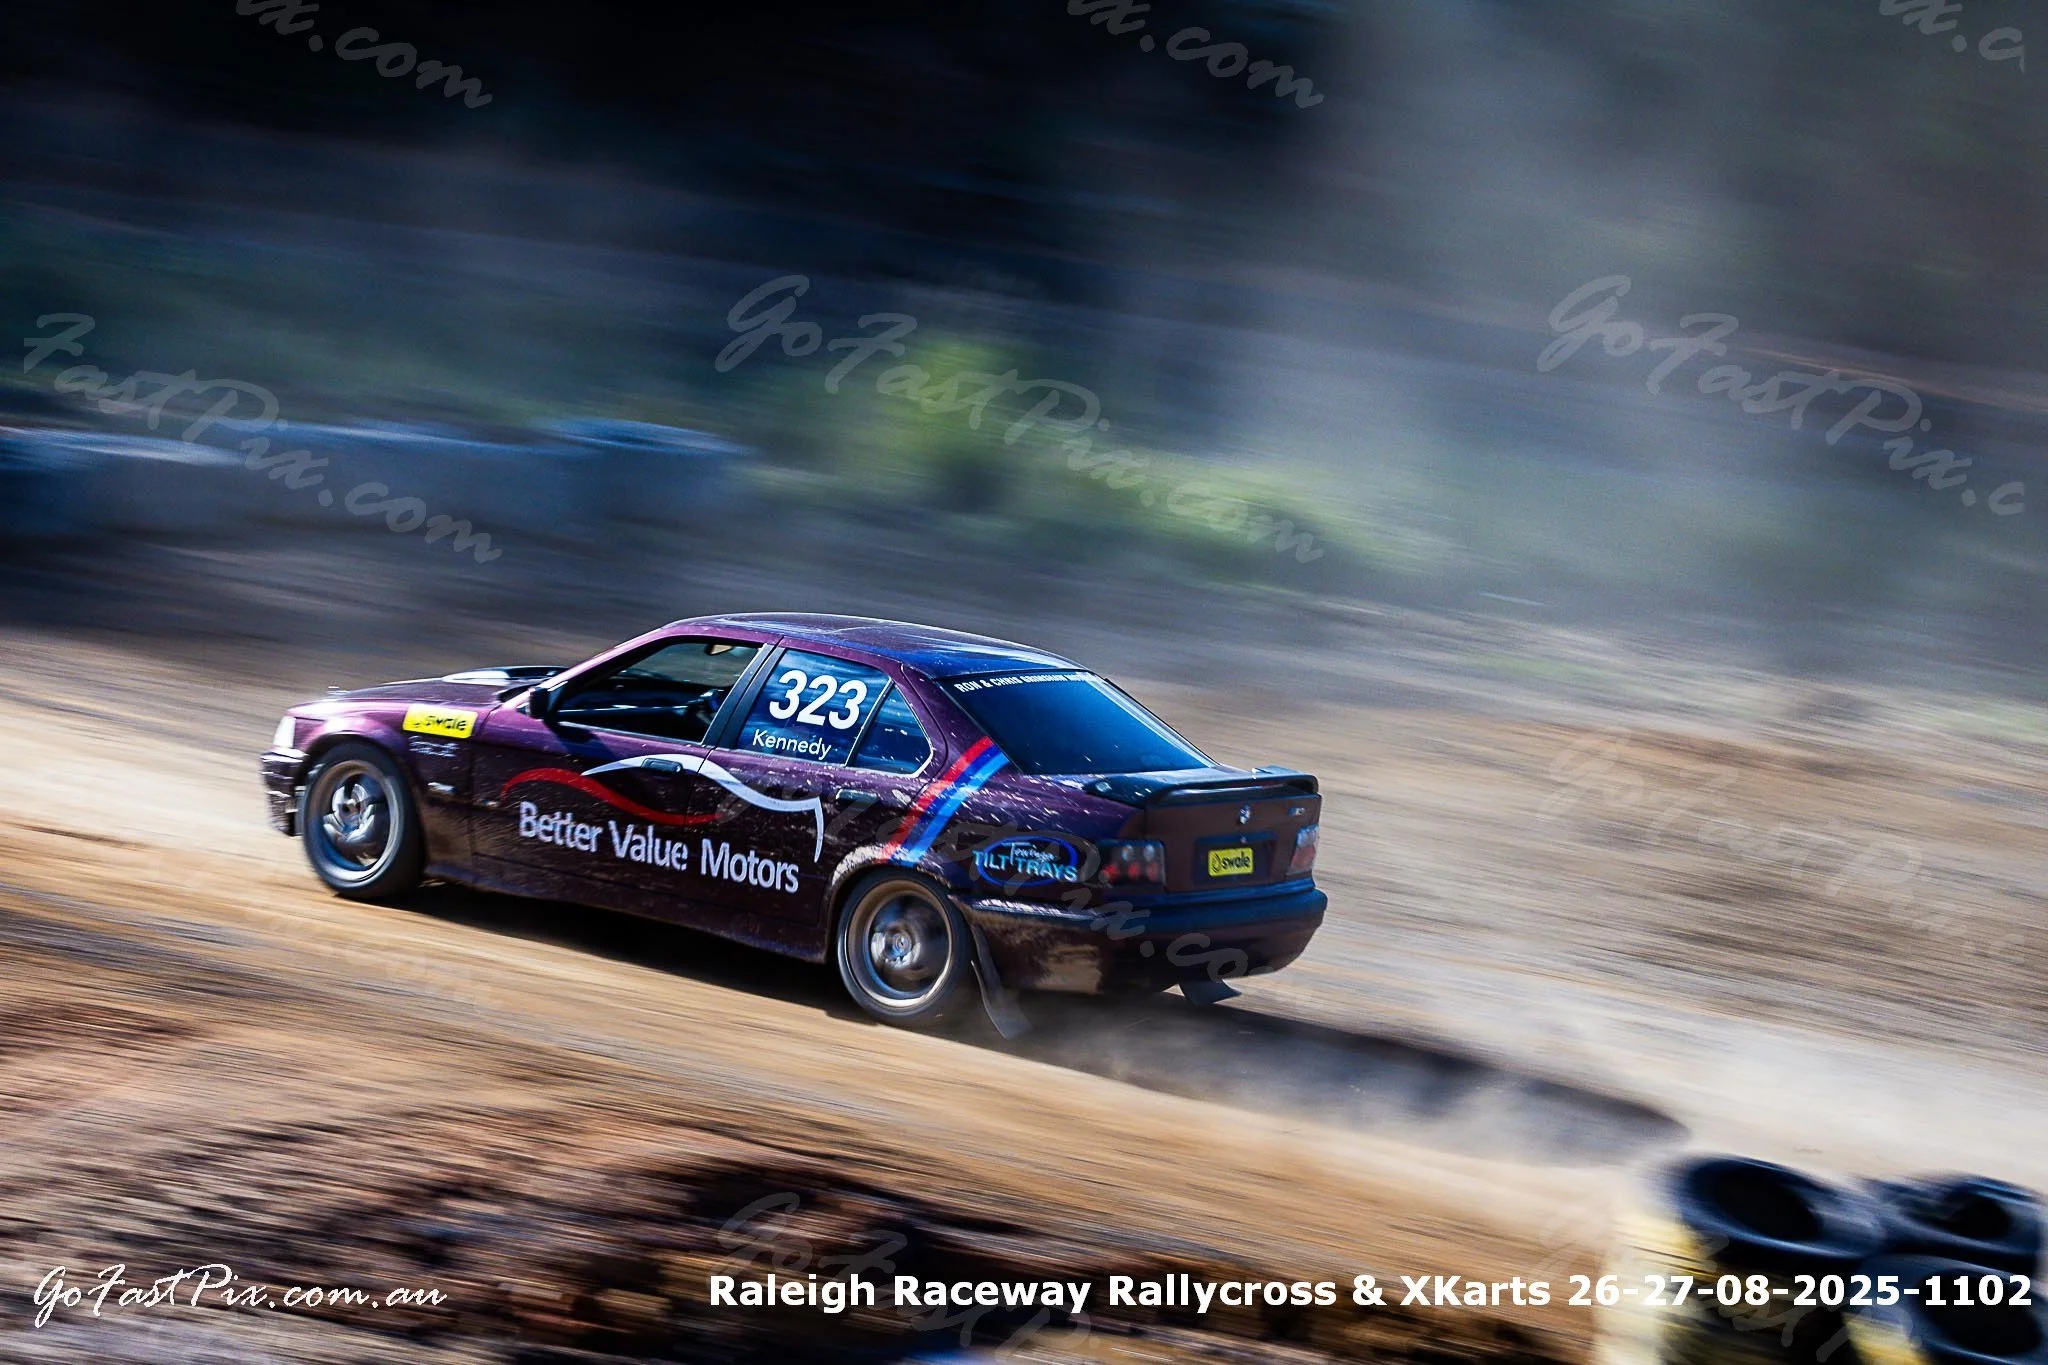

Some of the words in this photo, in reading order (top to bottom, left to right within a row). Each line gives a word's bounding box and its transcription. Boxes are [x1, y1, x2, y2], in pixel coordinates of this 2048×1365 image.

[769, 669, 868, 730] 323
[954, 680, 983, 693] RON
[980, 679, 994, 688] &
[989, 677, 1023, 687] CHRIS
[752, 729, 832, 760] Kennedy
[519, 801, 603, 853] Better
[608, 820, 688, 870] Value
[701, 838, 799, 894] Motors
[1221, 851, 1251, 869] swale
[972, 850, 1010, 870] TILT
[1015, 857, 1078, 882] TRAYS
